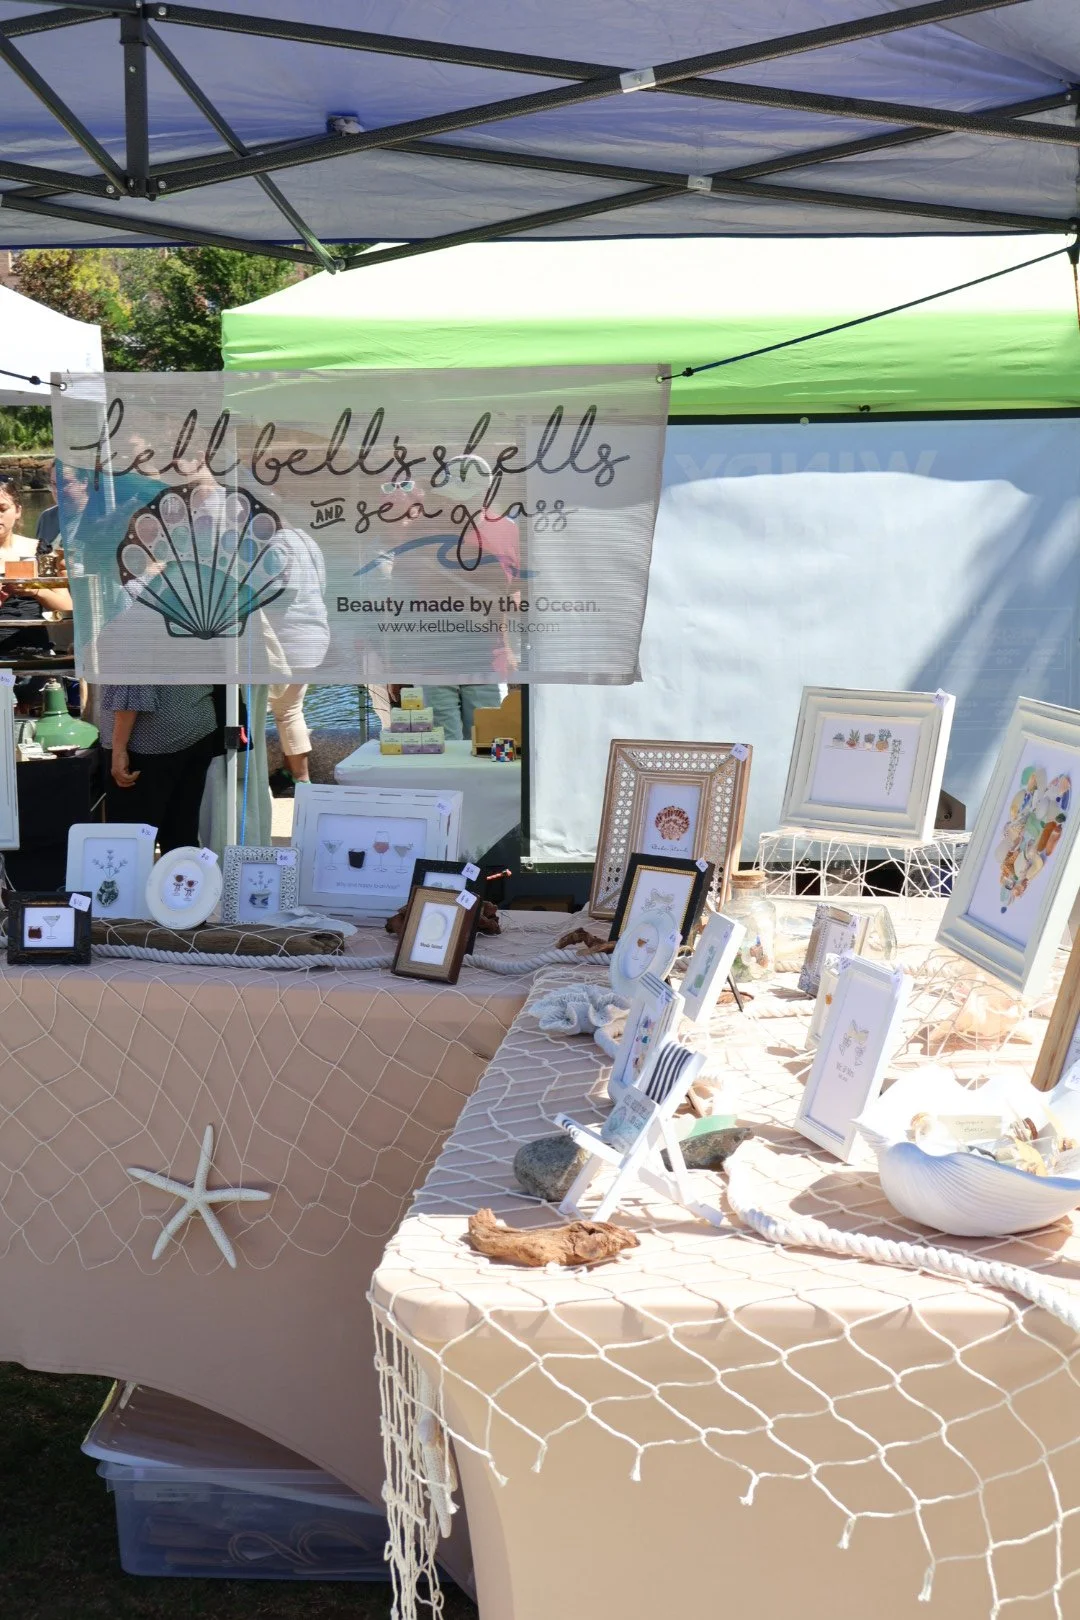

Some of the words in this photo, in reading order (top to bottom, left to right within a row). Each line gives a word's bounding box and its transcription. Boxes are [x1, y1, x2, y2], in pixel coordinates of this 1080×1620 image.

[314, 503, 346, 525] AND
[354, 500, 444, 534] sea
[450, 470, 580, 572] glass
[336, 596, 404, 617] Beauty
[409, 596, 465, 613] made
[469, 597, 492, 617] by
[498, 597, 530, 613] the
[377, 618, 562, 634] www.kellbellsshells.com
